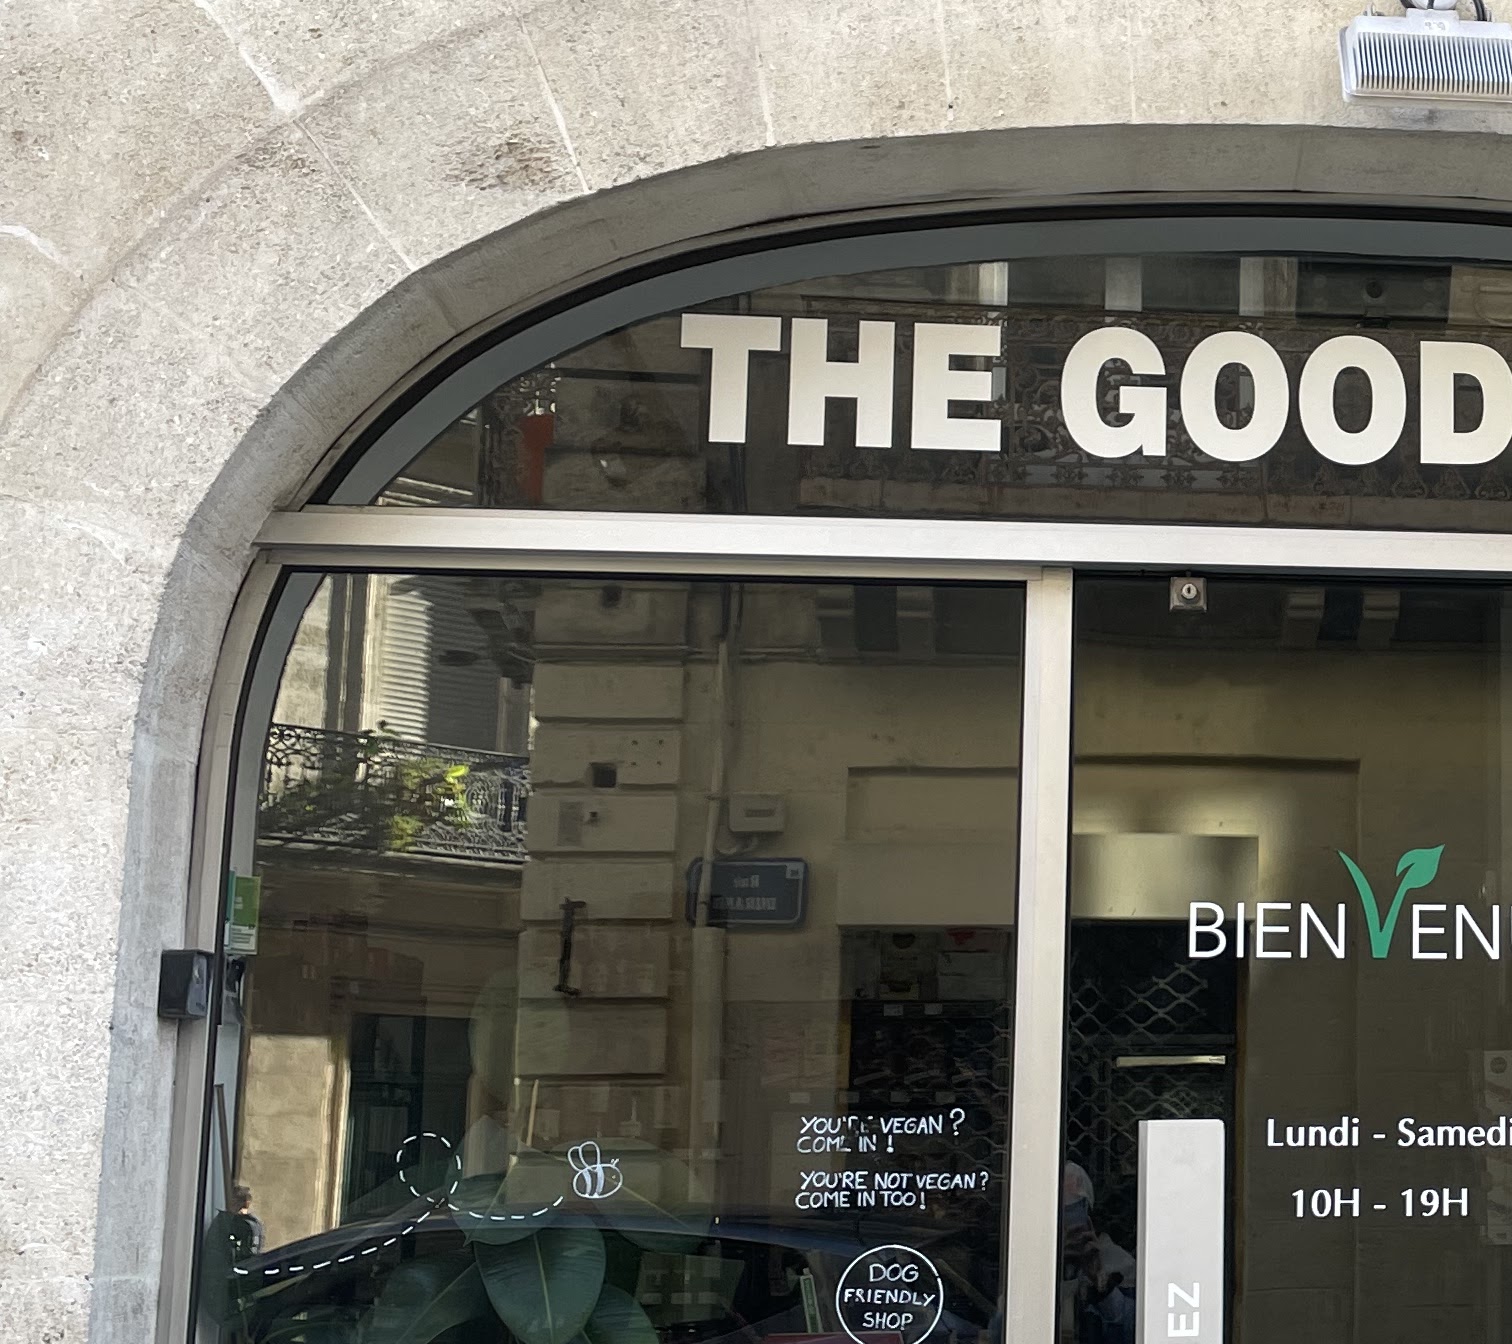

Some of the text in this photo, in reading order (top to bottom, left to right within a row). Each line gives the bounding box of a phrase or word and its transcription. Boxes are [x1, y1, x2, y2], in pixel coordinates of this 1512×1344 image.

[680, 312, 1003, 452] THE
[1267, 1116, 1360, 1147] Lundi
[800, 1170, 869, 1190] YOU'RE
[874, 1171, 913, 1191] NOT
[794, 1190, 851, 1210] COME
[857, 1190, 876, 1208] IN
[1291, 1187, 1360, 1218] 10H
[1400, 1187, 1469, 1218] 19H
[868, 1262, 920, 1283] DOG
[843, 1288, 936, 1308] FRIENDLY
[861, 1311, 914, 1331] SHOP
